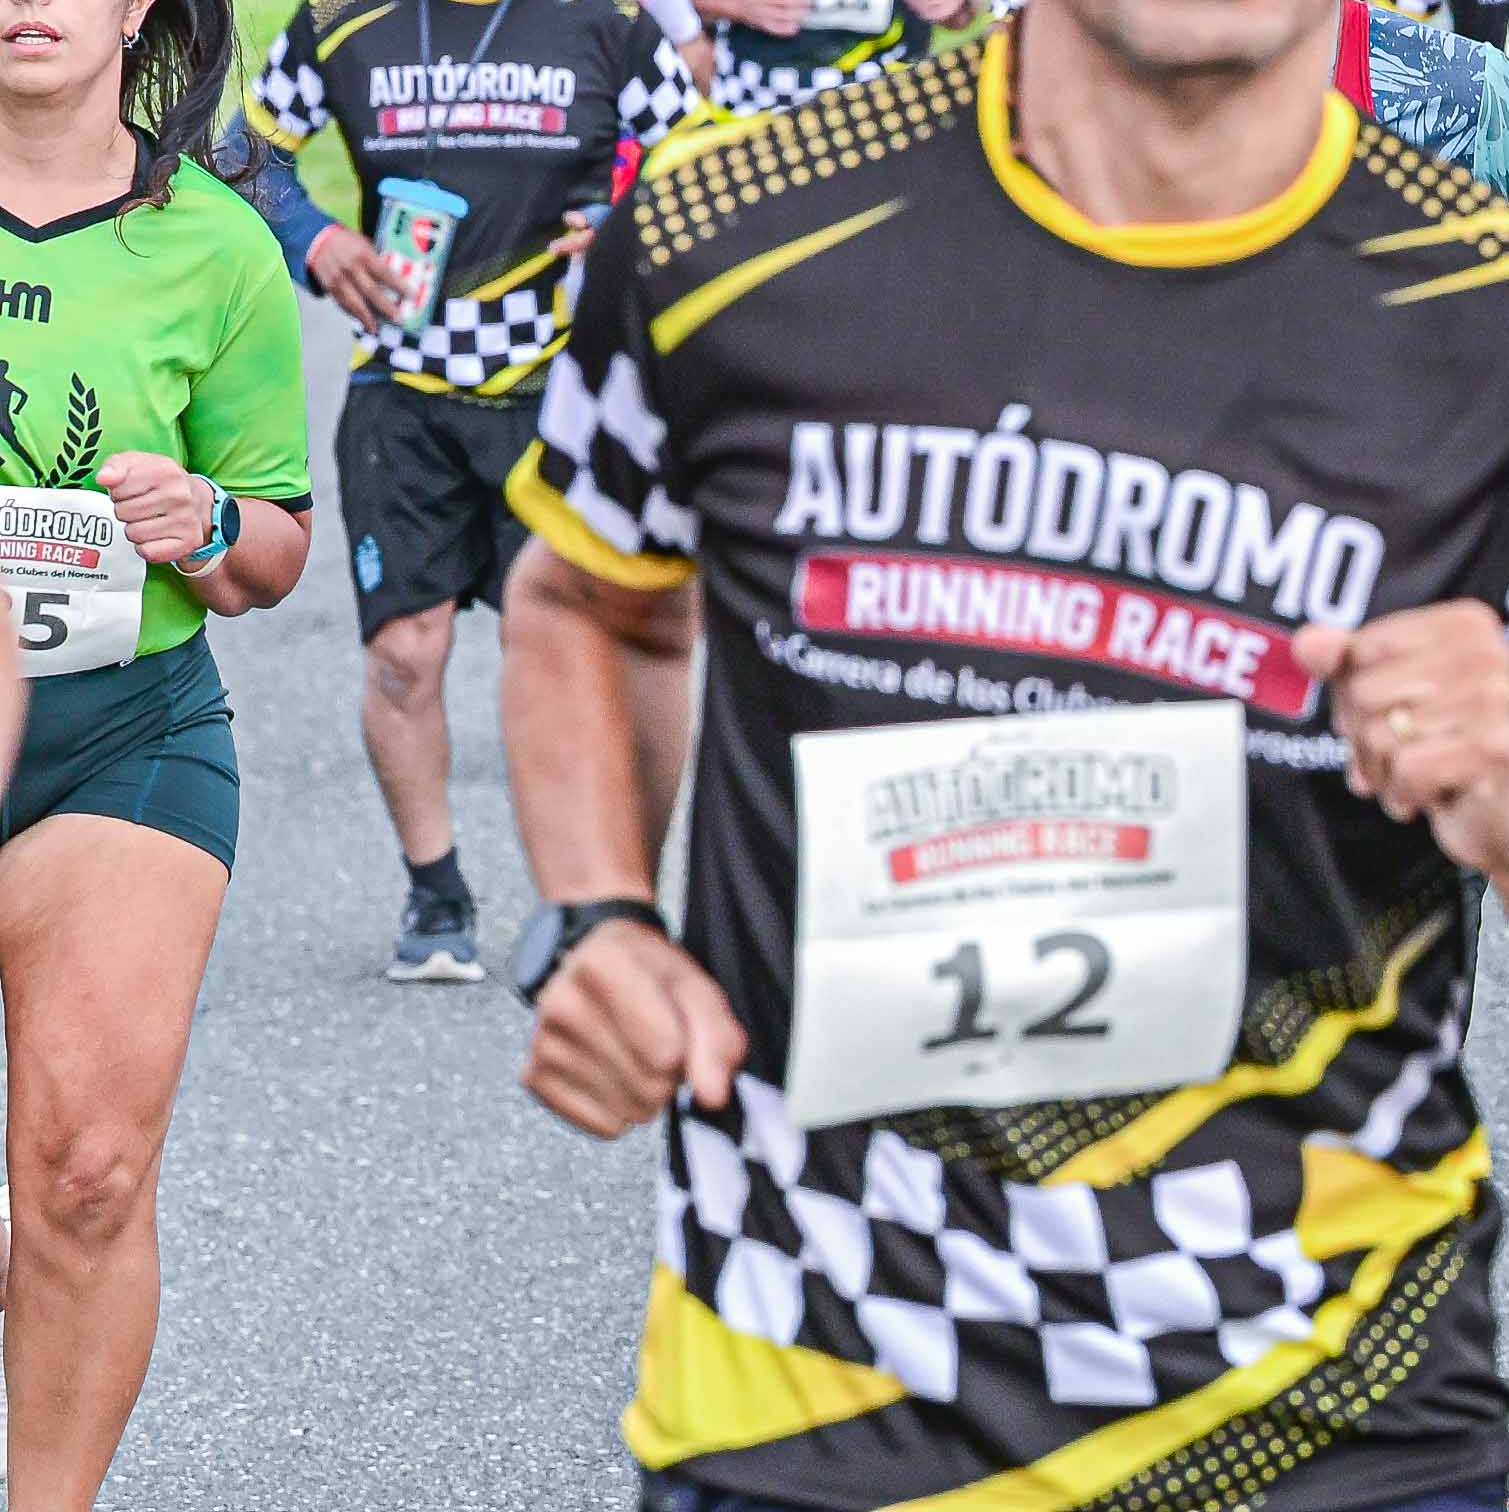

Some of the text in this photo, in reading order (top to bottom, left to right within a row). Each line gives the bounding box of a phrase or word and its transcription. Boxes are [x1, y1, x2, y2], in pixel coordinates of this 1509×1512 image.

[0, 498, 113, 547] ÓDROMO
[773, 402, 1386, 631] AUTÓDROMO
[0, 541, 84, 565] NING RACE
[16, 566, 48, 577] Clubes
[18, 591, 70, 650] 5
[845, 563, 1269, 701] RUNNING RACE
[921, 931, 1113, 1050] 12
